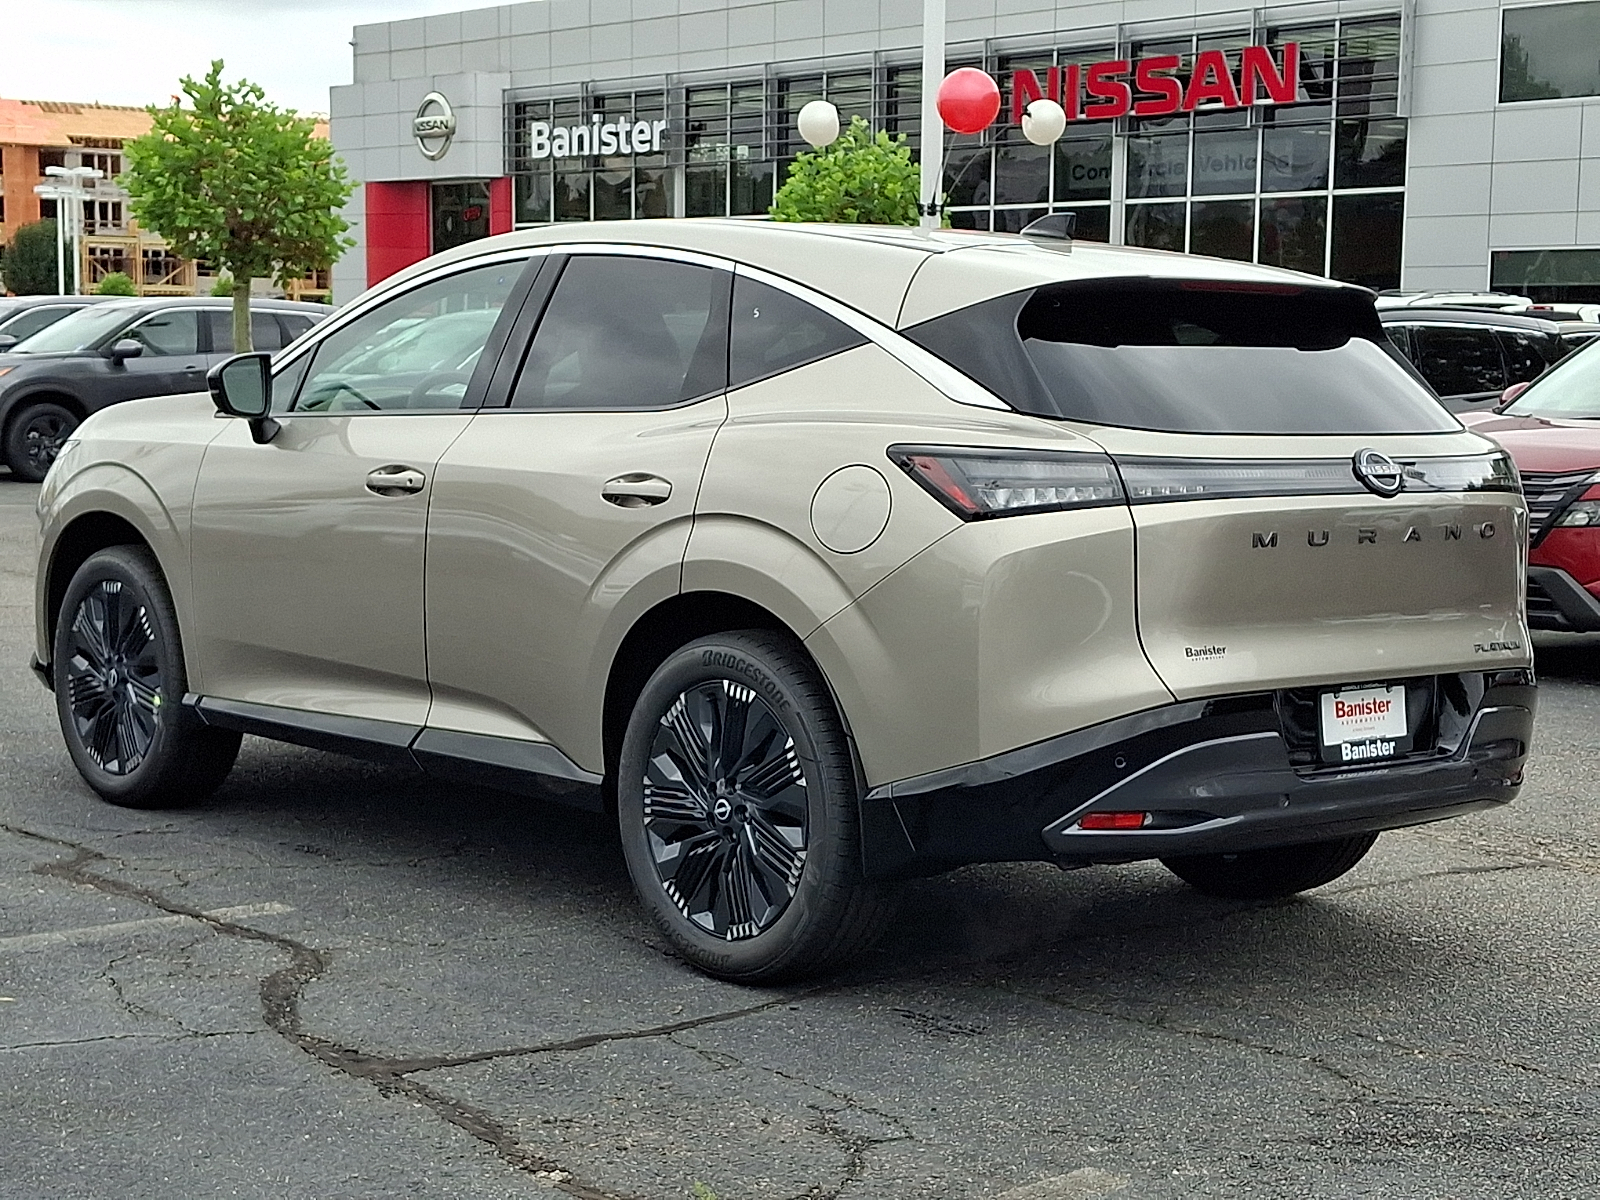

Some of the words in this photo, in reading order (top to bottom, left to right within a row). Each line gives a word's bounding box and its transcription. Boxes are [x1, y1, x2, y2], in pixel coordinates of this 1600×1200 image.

[1012, 42, 1299, 124] NISSAN
[531, 113, 667, 158] Banister
[1072, 160, 1187, 181] Comrcia
[1199, 153, 1290, 173] Vehics
[1252, 521, 1496, 549] MURANO
[1184, 645, 1227, 658] Banister
[702, 649, 791, 713] BRIDGESTONE
[1334, 697, 1391, 719] Banister
[1341, 740, 1396, 761] Banister
